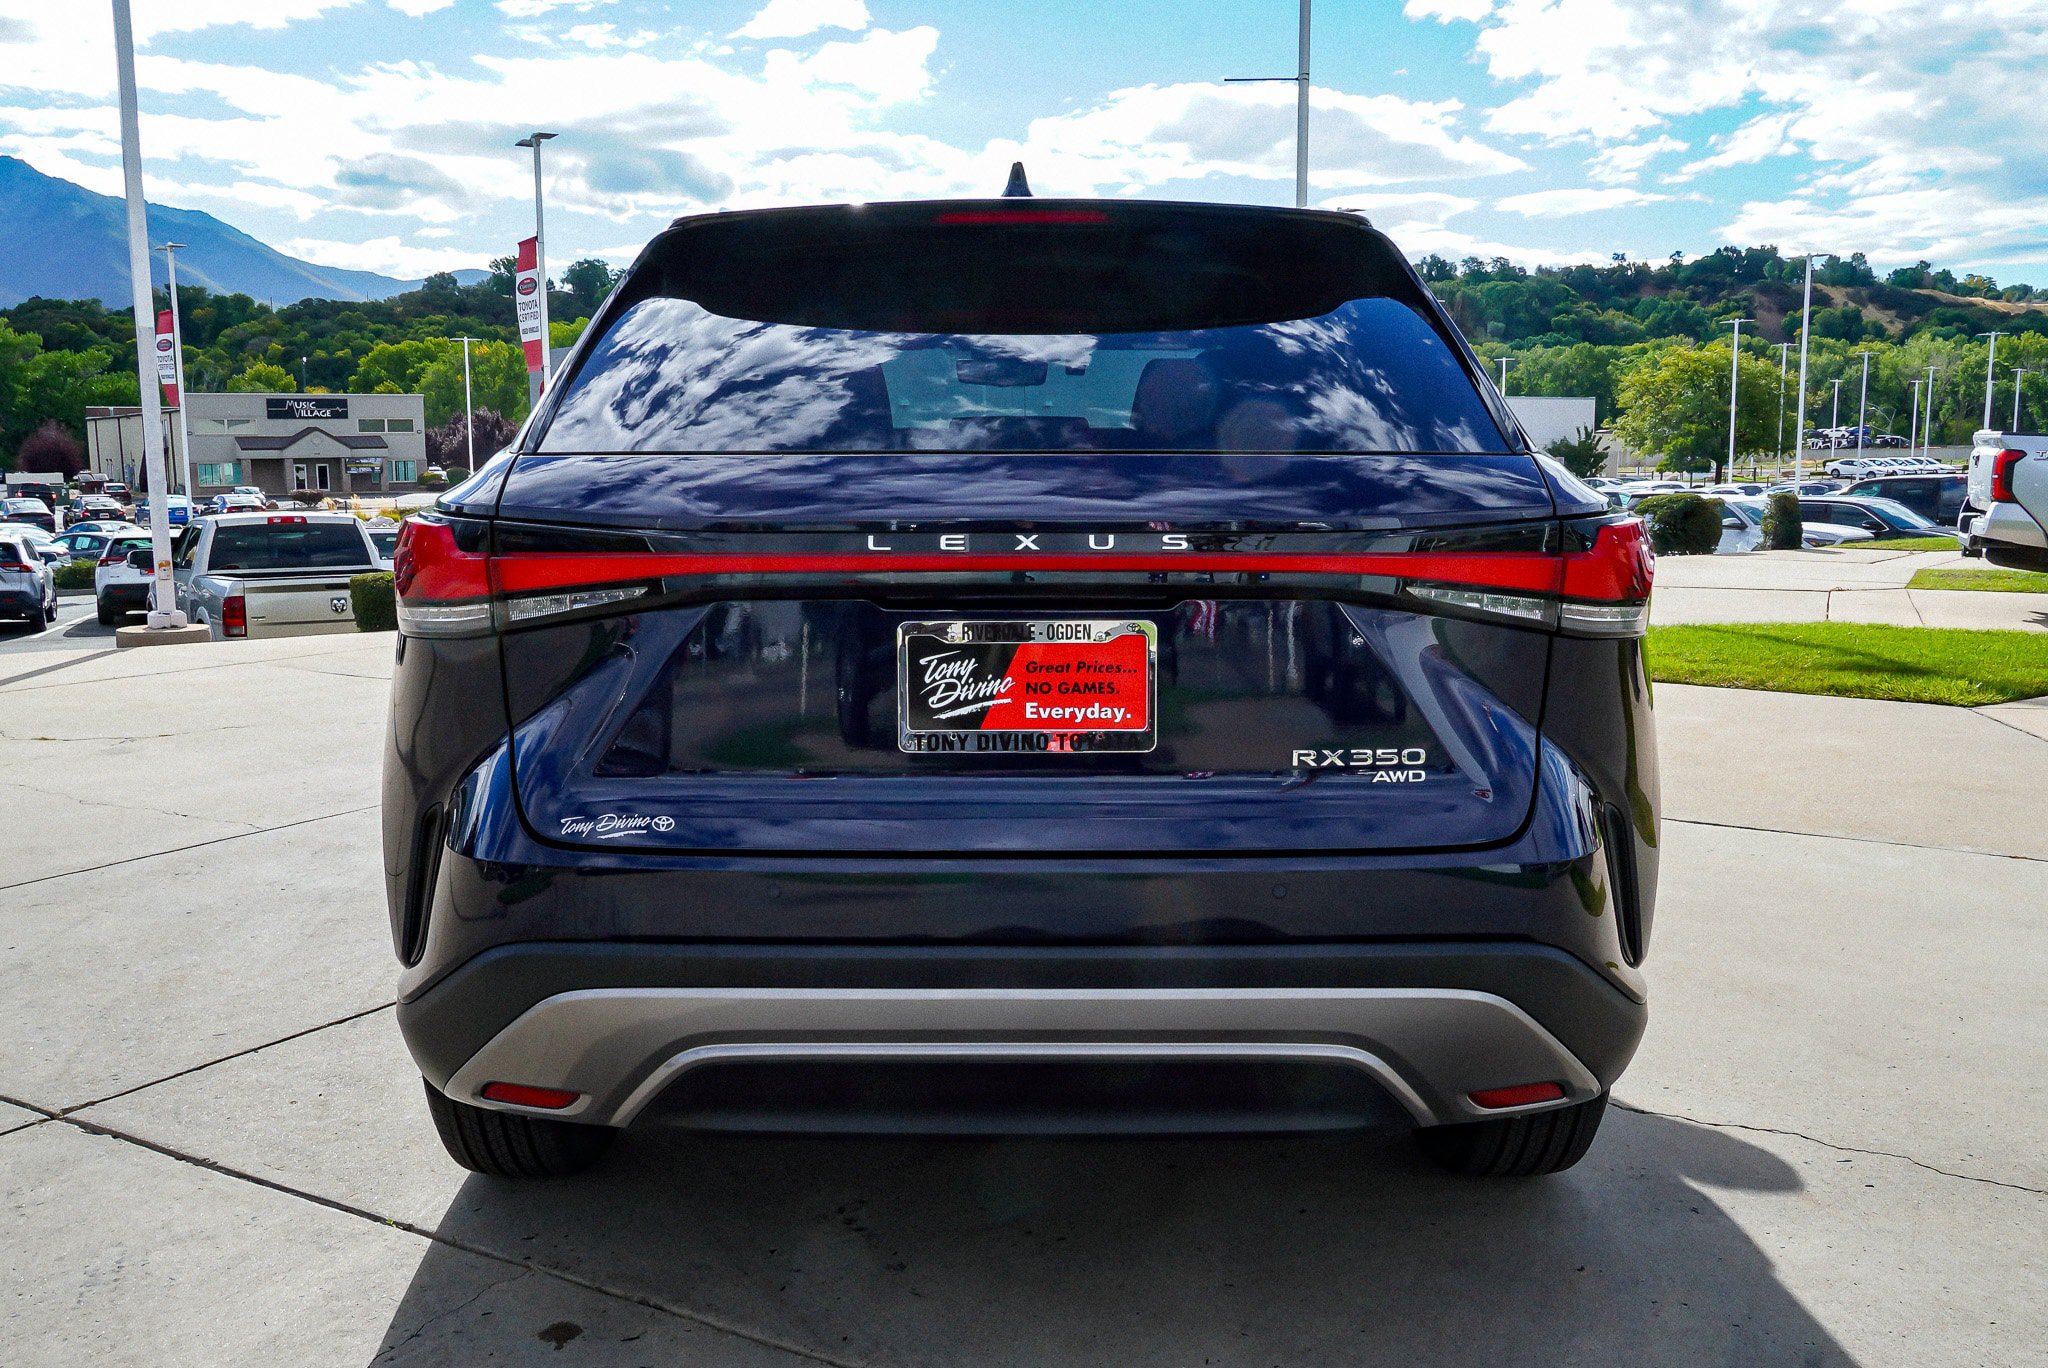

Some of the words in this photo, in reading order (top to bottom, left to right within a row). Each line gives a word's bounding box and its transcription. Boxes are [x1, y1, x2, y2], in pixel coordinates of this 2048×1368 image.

[518, 299, 539, 312] TOYOTA
[519, 310, 539, 323] CERTIFIED
[285, 400, 317, 410] MUSIC
[294, 408, 332, 418] VILLAGE
[867, 534, 1189, 551] LEXUS
[1046, 623, 1092, 641] OGDEN
[919, 650, 979, 684] Tony
[1025, 661, 1071, 673] Great
[1076, 660, 1138, 673] Prices...
[919, 674, 1016, 709] Divino
[1025, 682, 1052, 694] NO
[1057, 682, 1120, 694] GAMES.
[1025, 702, 1132, 722] Everyday.
[913, 732, 969, 750] TONY
[976, 733, 1049, 751] DIVINO
[1372, 770, 1426, 783] AWD
[560, 816, 595, 837] Tony
[595, 814, 652, 831] Divino
